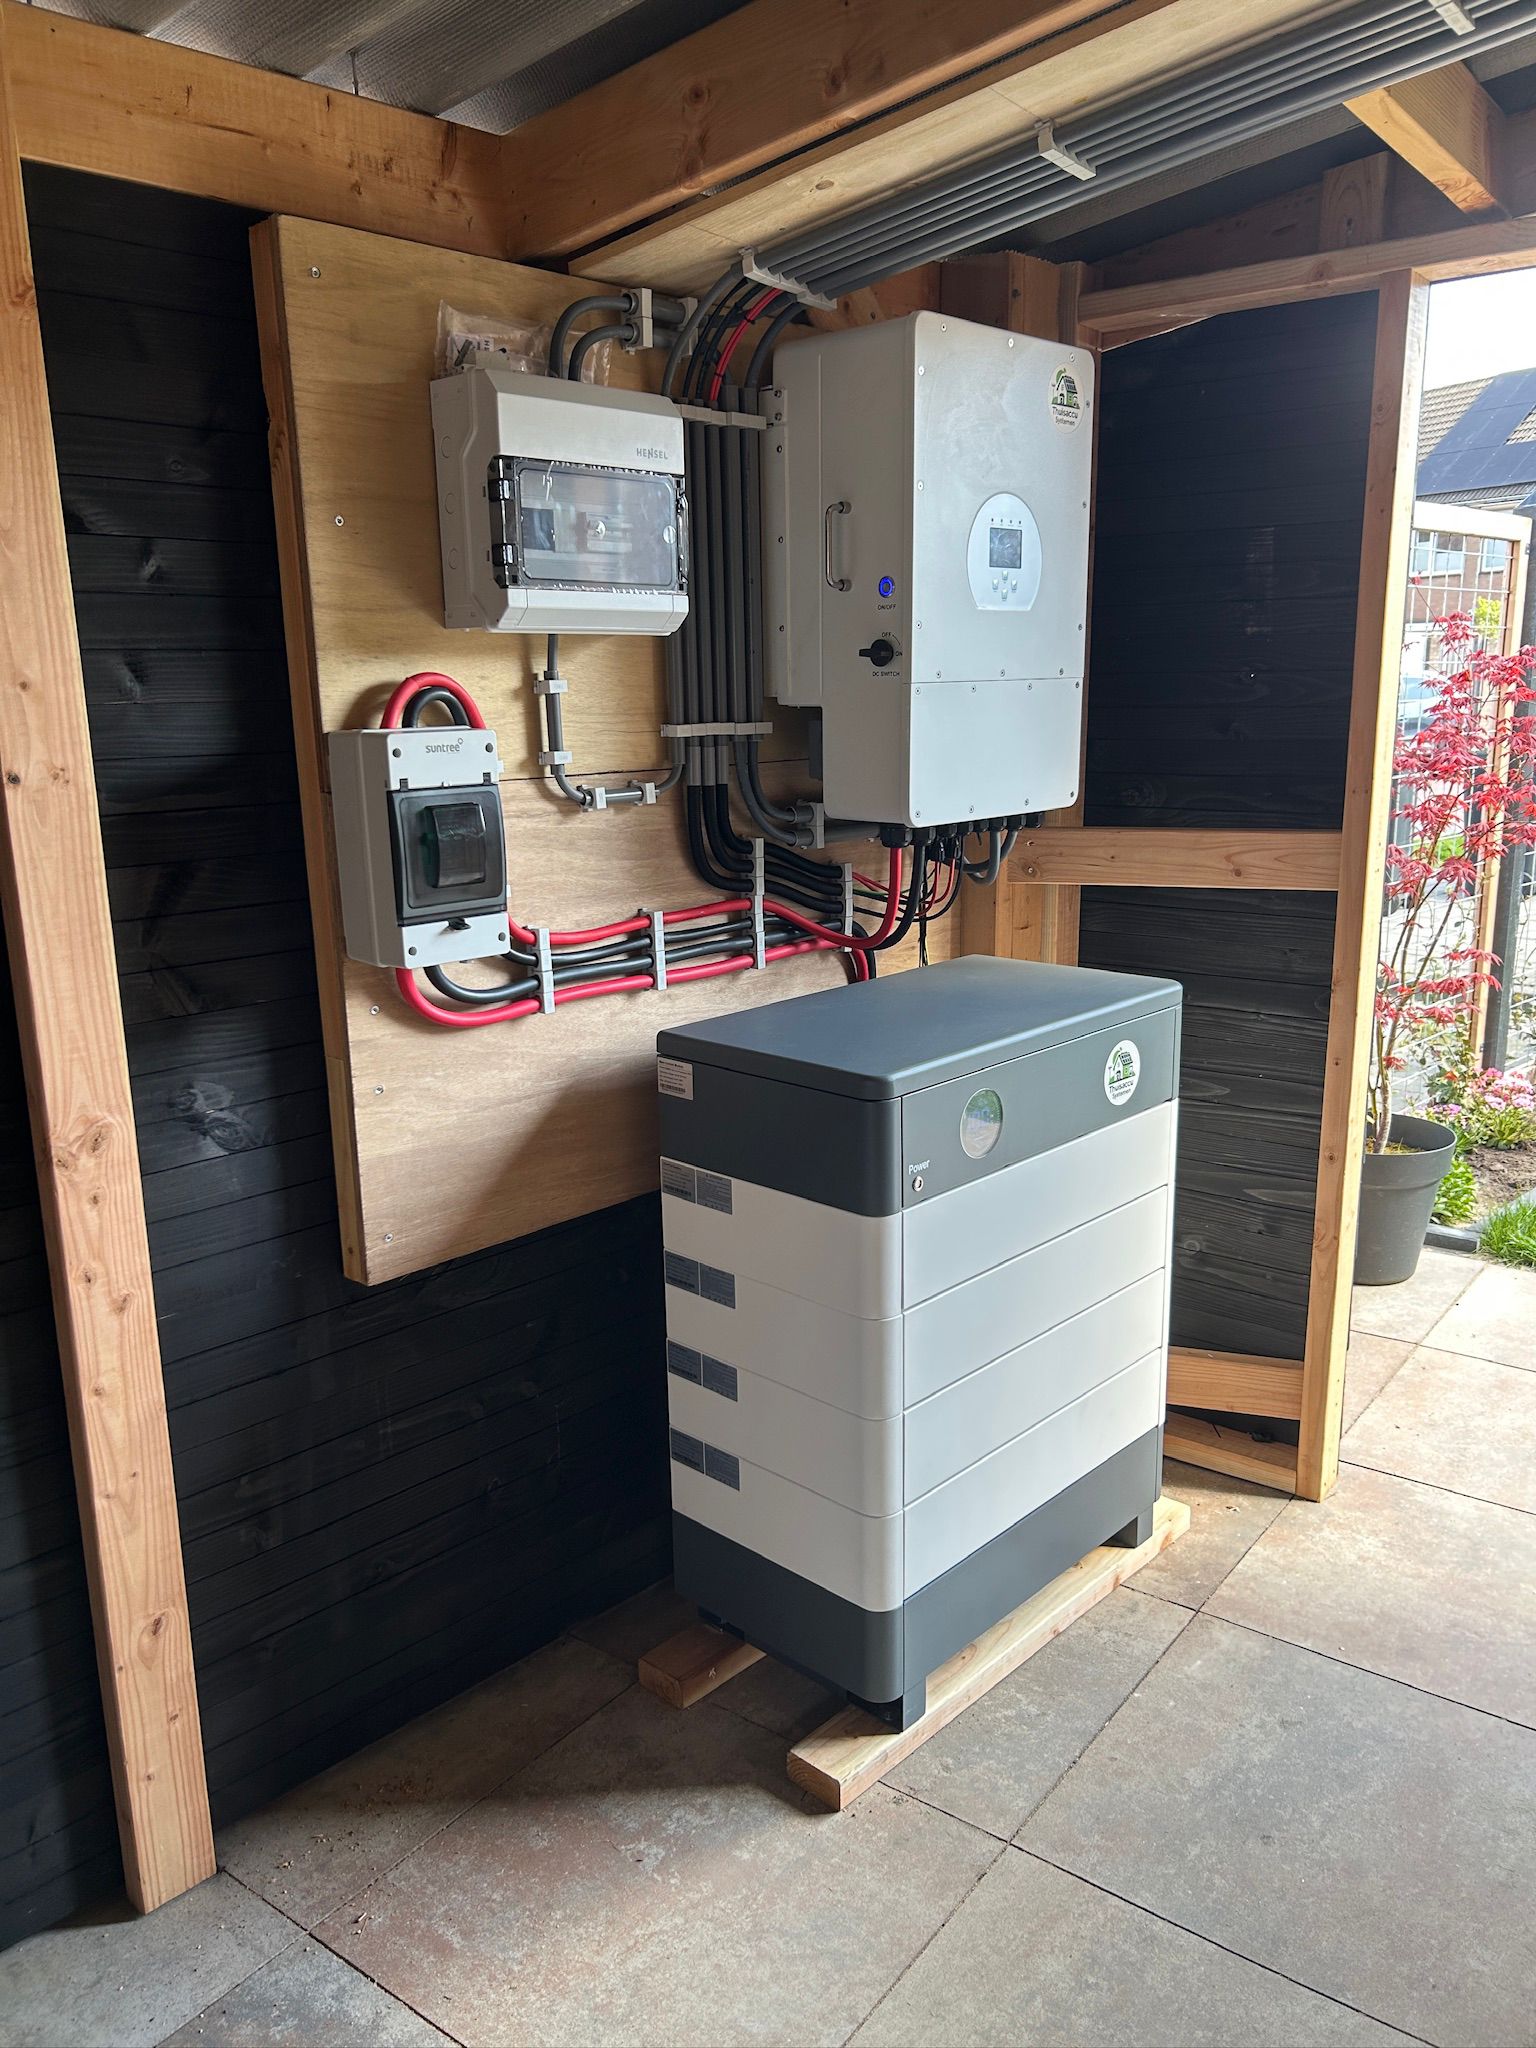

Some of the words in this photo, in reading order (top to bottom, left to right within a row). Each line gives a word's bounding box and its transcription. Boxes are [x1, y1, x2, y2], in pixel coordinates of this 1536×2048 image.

[636, 447, 669, 460] HENSEL
[425, 744, 460, 754] suntree
[1109, 1080, 1134, 1093] Thuisaccu
[908, 1159, 930, 1175] Power
